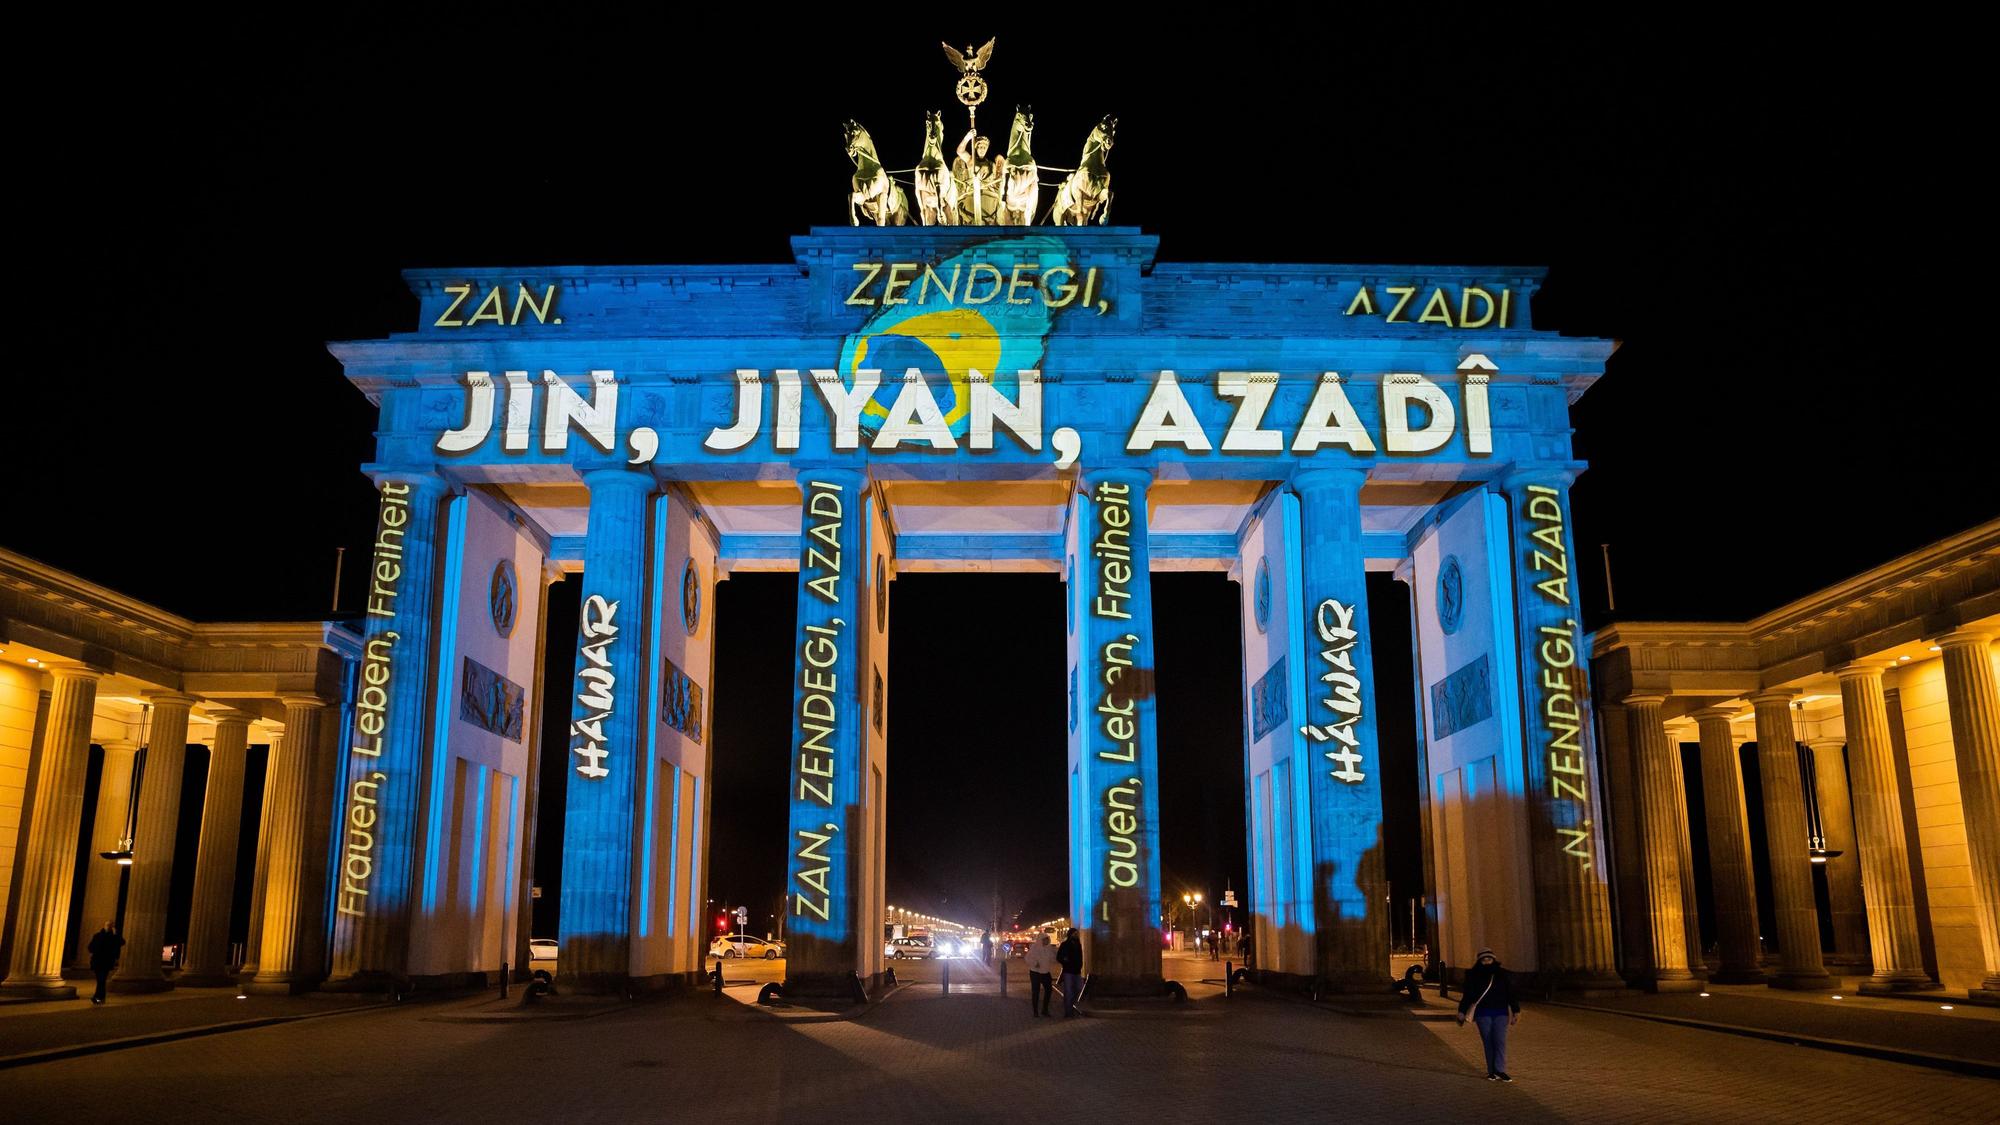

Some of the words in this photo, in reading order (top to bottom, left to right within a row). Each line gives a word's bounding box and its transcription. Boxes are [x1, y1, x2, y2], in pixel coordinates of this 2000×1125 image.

[843, 262, 1109, 317] ZENDEGI,
[436, 369, 660, 465] JIN,
[703, 367, 1082, 470] JIYAN,
[1126, 353, 1499, 454] AZADÎ
[368, 481, 411, 618] Freiheit
[807, 481, 843, 602] AZADI
[1095, 481, 1132, 619] Freiheit
[1527, 485, 1570, 605] AZADI
[353, 631, 401, 757] Leben,
[800, 616, 846, 804] ZENDEGI,
[338, 773, 388, 917] Frauen,
[796, 822, 840, 921] ZAN,
[1102, 777, 1143, 921] auen,
